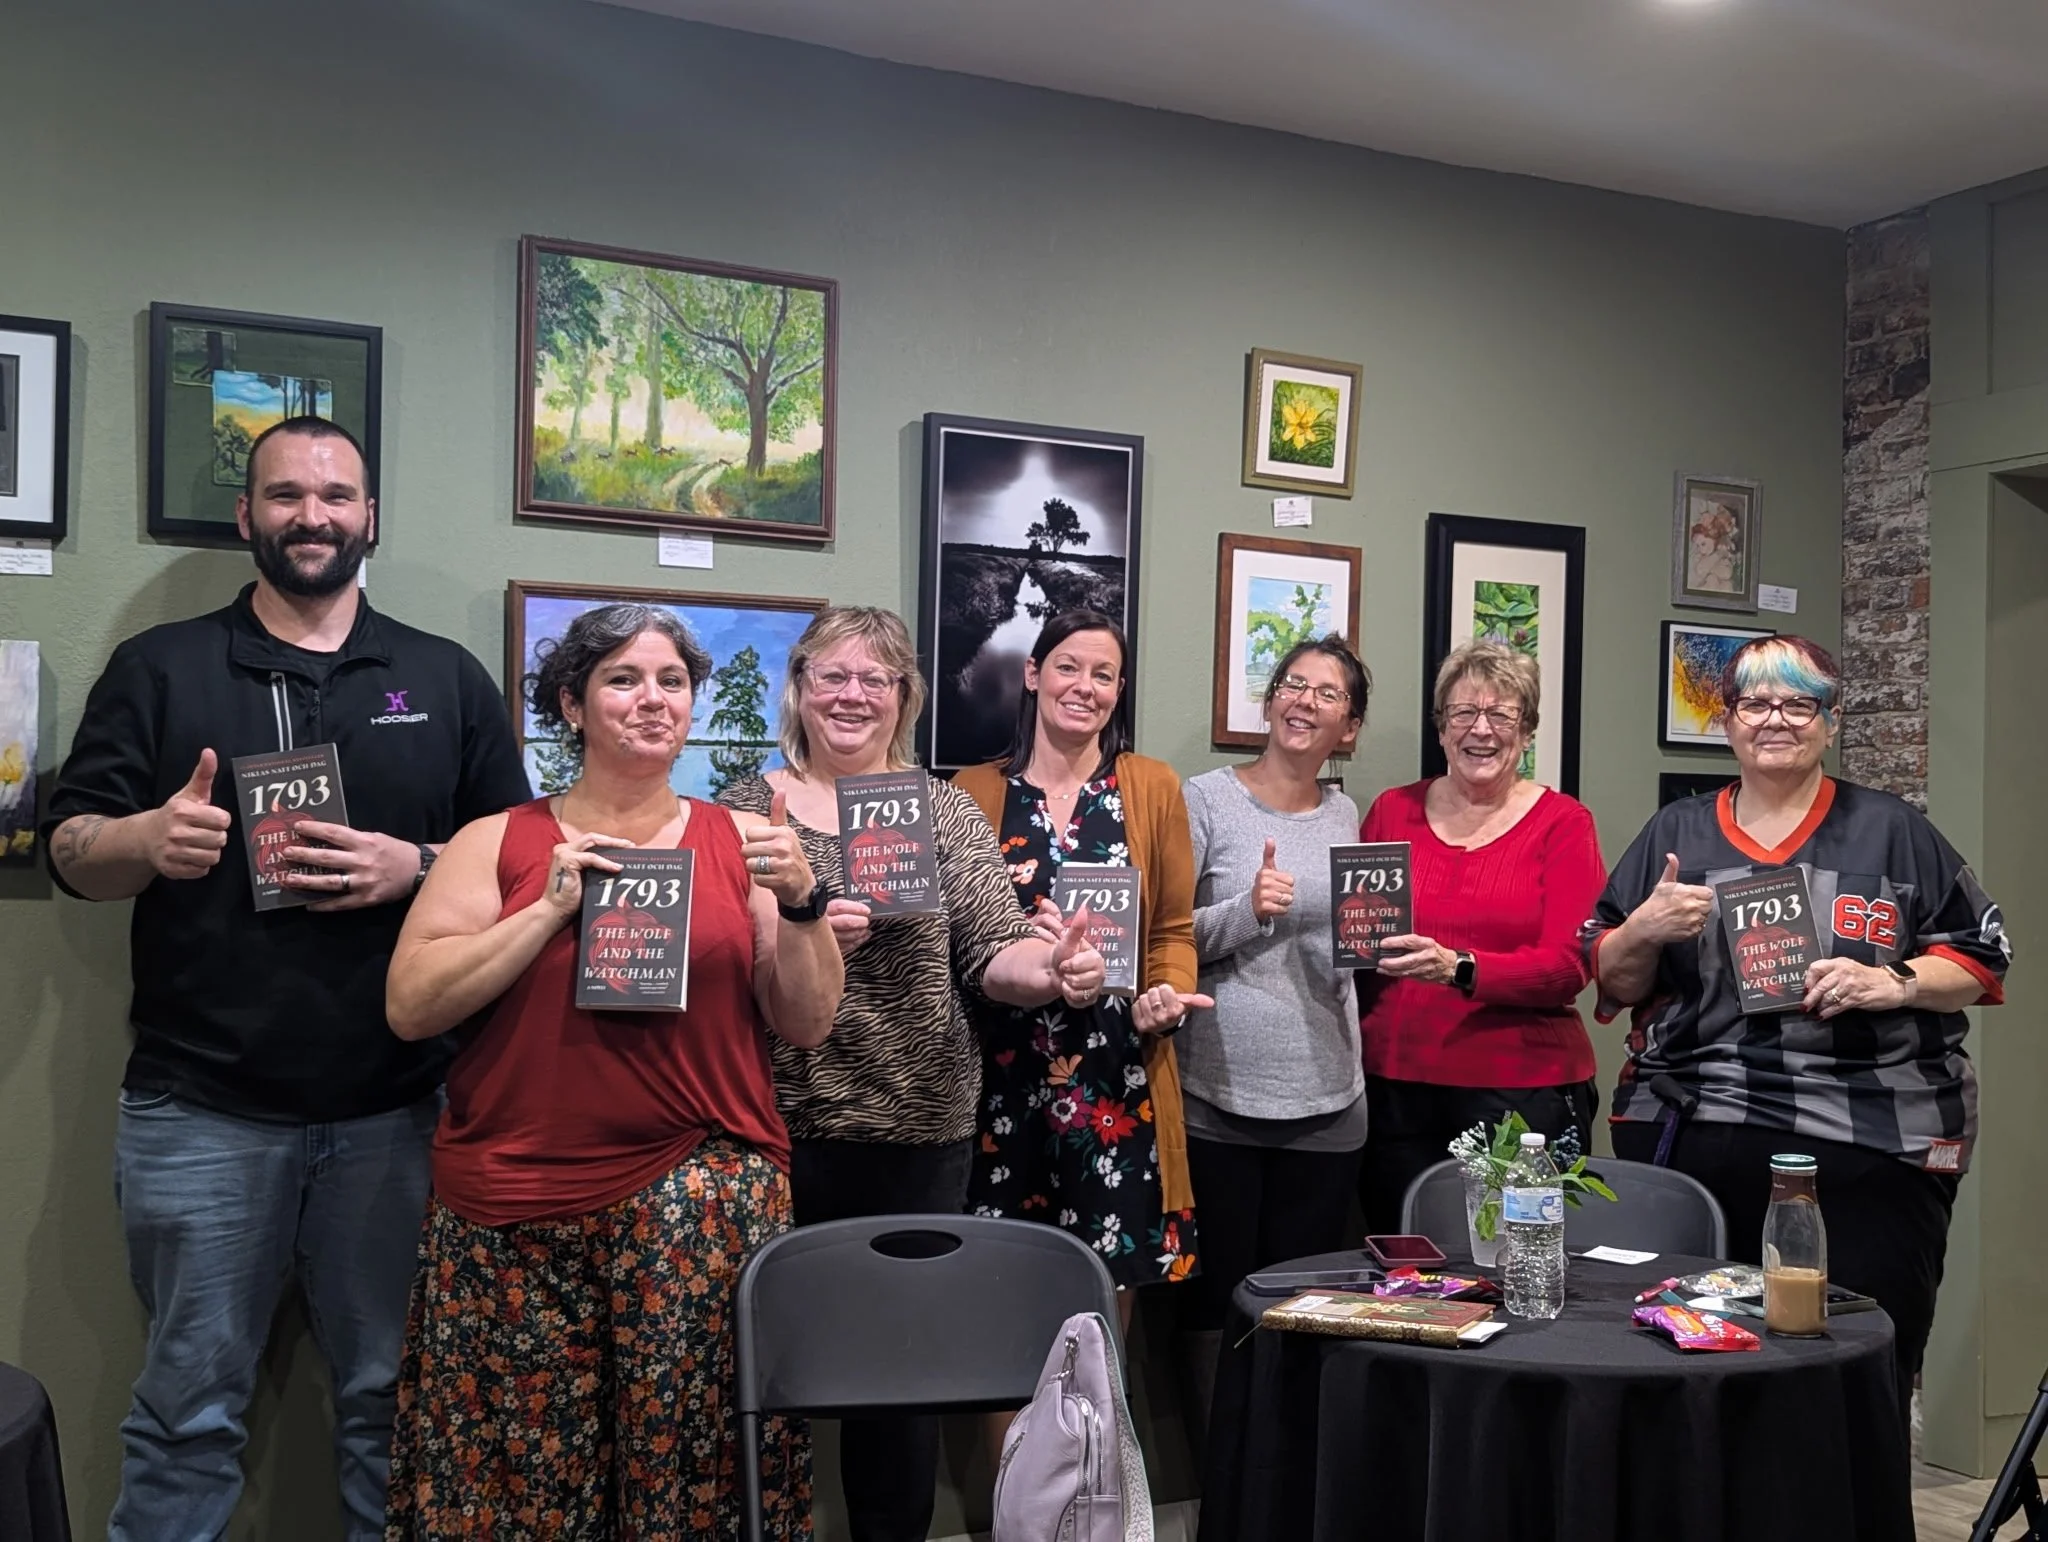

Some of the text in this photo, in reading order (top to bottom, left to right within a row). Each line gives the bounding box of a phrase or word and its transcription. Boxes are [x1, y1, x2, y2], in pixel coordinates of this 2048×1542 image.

[370, 713, 428, 725] HOOSIER
[241, 769, 270, 778] NIKLAS
[249, 775, 331, 816] 1793
[848, 797, 921, 830] 1793
[257, 831, 288, 846] THE
[854, 842, 919, 858] THE WOLF
[860, 860, 917, 876] AND THE
[851, 877, 930, 894] WATCHMAN
[1340, 868, 1404, 894] 1793
[594, 877, 681, 908] 1793
[1062, 888, 1130, 912] 1793
[1343, 907, 1400, 919] THE WOLF
[1731, 894, 1802, 931] 1793
[1347, 923, 1397, 934] AND THE
[1831, 894, 1897, 950] 62
[596, 927, 672, 940] THE WOLF
[1090, 927, 1124, 937] WOLF
[1095, 942, 1119, 952] THE
[1338, 939, 1379, 950] WATCH
[1741, 936, 1805, 957] THE WOLF
[598, 947, 664, 959] AND THE
[1750, 953, 1804, 973] AND THE
[584, 967, 677, 980] WATCHMAN
[1742, 969, 1808, 991] WATCHMA
